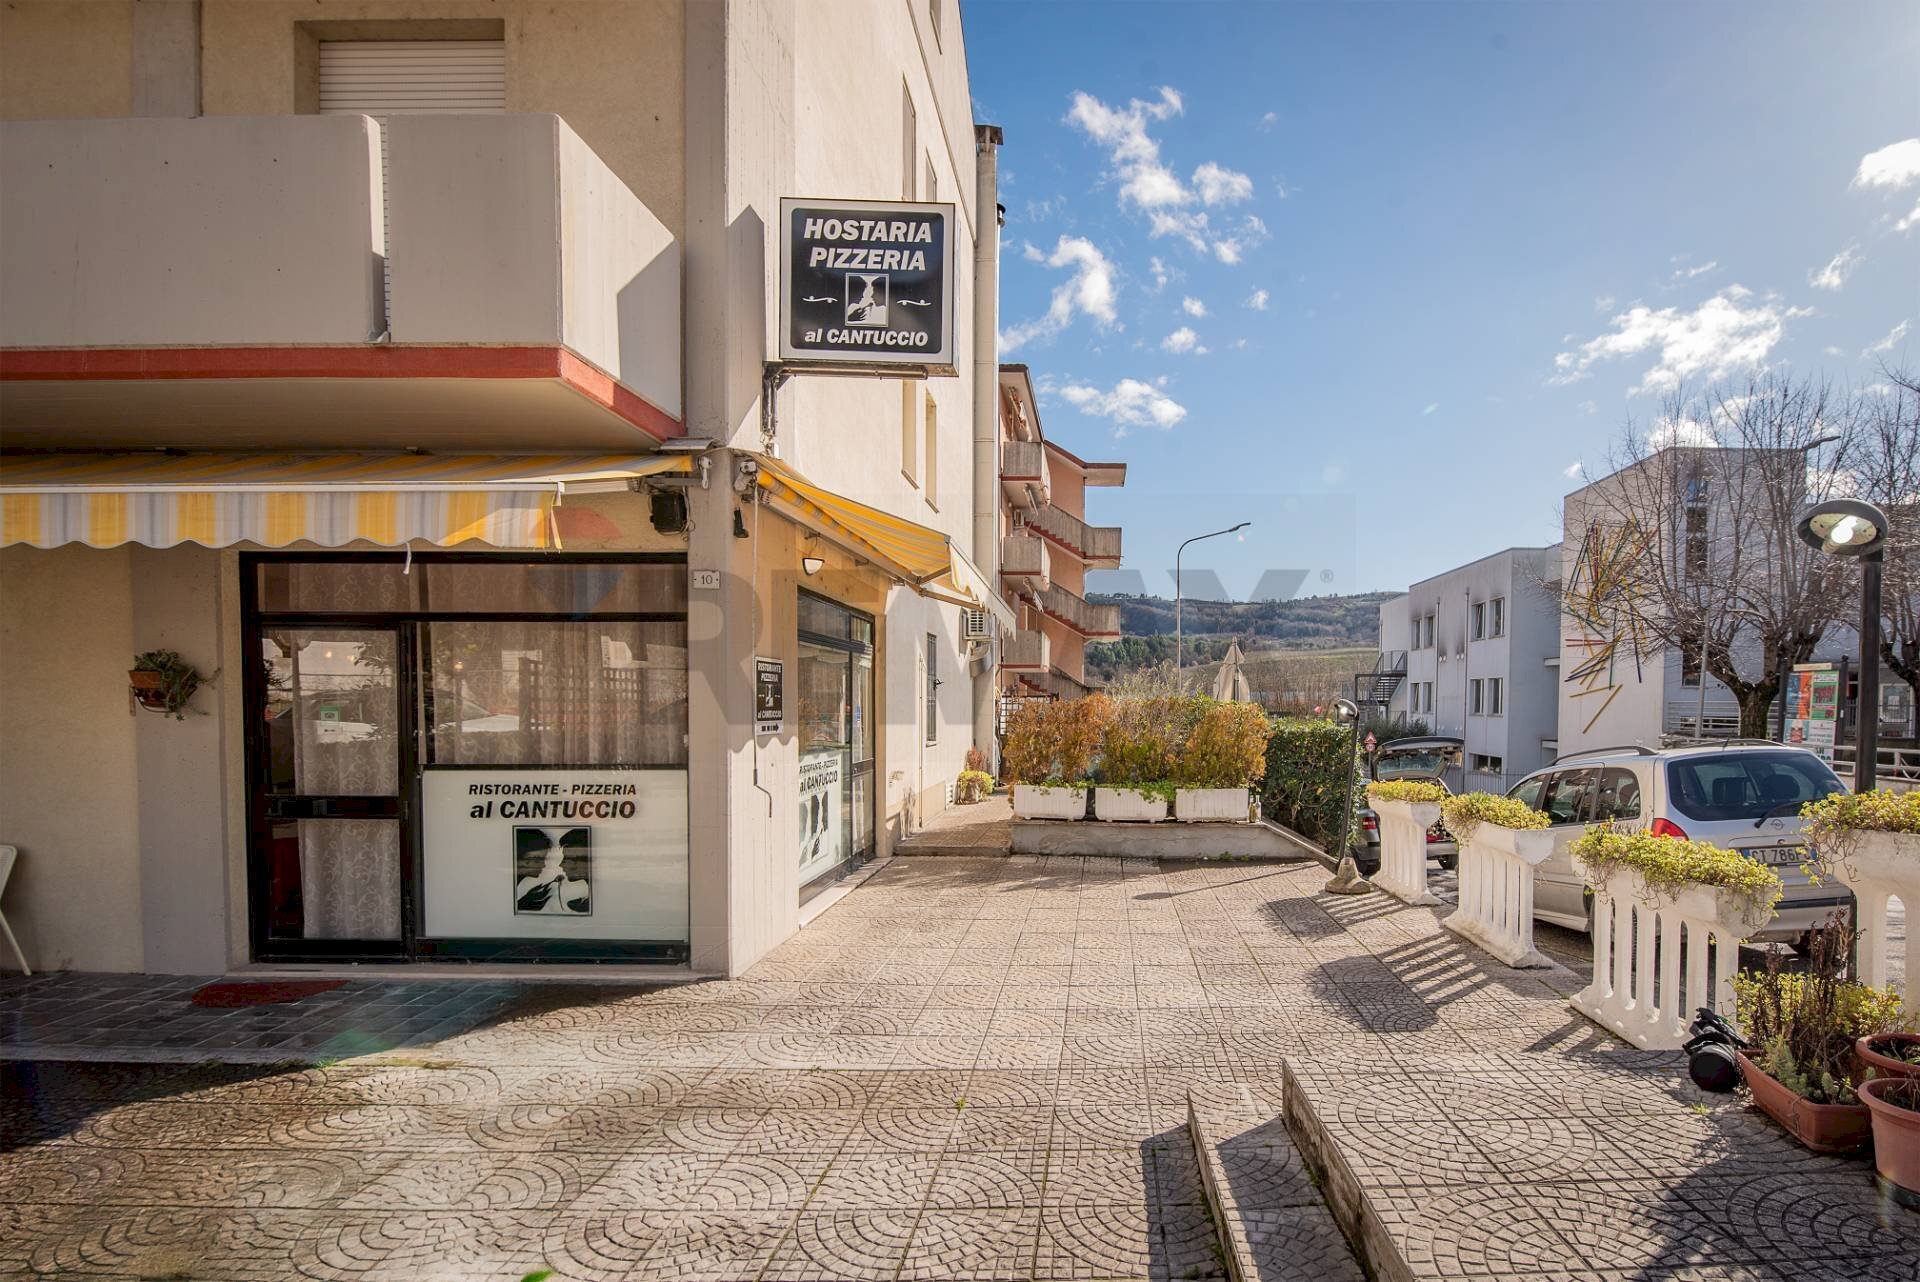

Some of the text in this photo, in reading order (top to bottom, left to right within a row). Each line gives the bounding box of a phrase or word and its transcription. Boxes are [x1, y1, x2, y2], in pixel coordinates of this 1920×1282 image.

[803, 218, 932, 243] HOSTARIA
[809, 247, 926, 271] PIZZERIA
[804, 328, 929, 347] al CANTUCCIO
[701, 574, 713, 585] 10
[469, 784, 559, 795] RISTORANTE
[571, 784, 637, 795] PIZZERIA
[807, 770, 838, 790] CANTUCCIO
[470, 800, 636, 819] al CANTUCCIO
